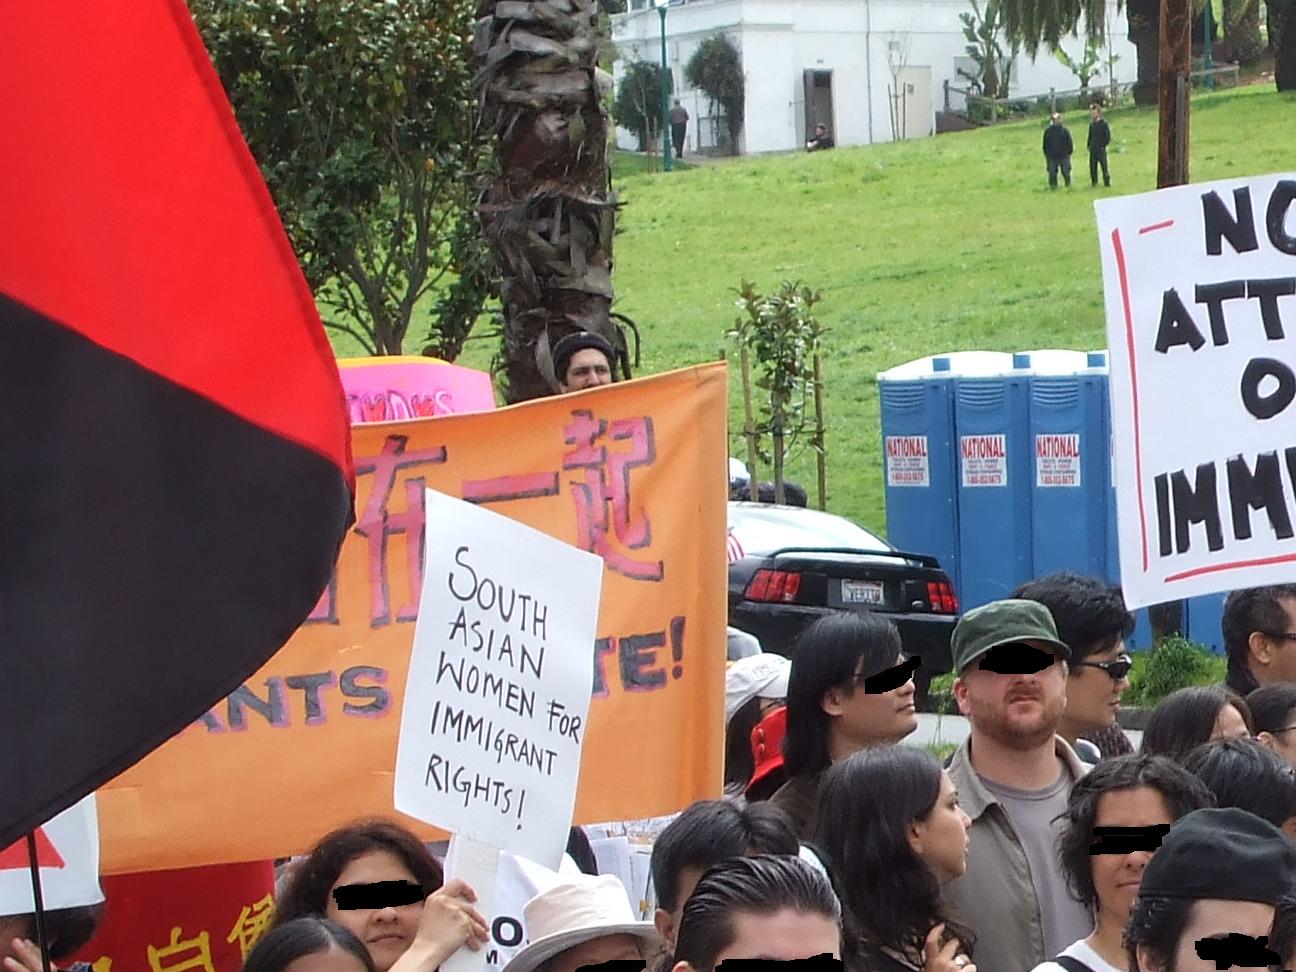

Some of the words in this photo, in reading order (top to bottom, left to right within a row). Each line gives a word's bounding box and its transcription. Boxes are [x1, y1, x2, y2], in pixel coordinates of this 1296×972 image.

[887, 437, 927, 457] NATIONAL
[962, 436, 1005, 458] NATIONAL
[1037, 436, 1080, 458] NATIONAL
[449, 546, 548, 641] SOUTH
[448, 605, 544, 680] ASIAN
[196, 664, 394, 734] NTS
[436, 651, 536, 719] WOMEN
[547, 699, 581, 744] FOR
[431, 700, 557, 776] IMMIGRANT
[425, 754, 526, 831] RIGHTS!
